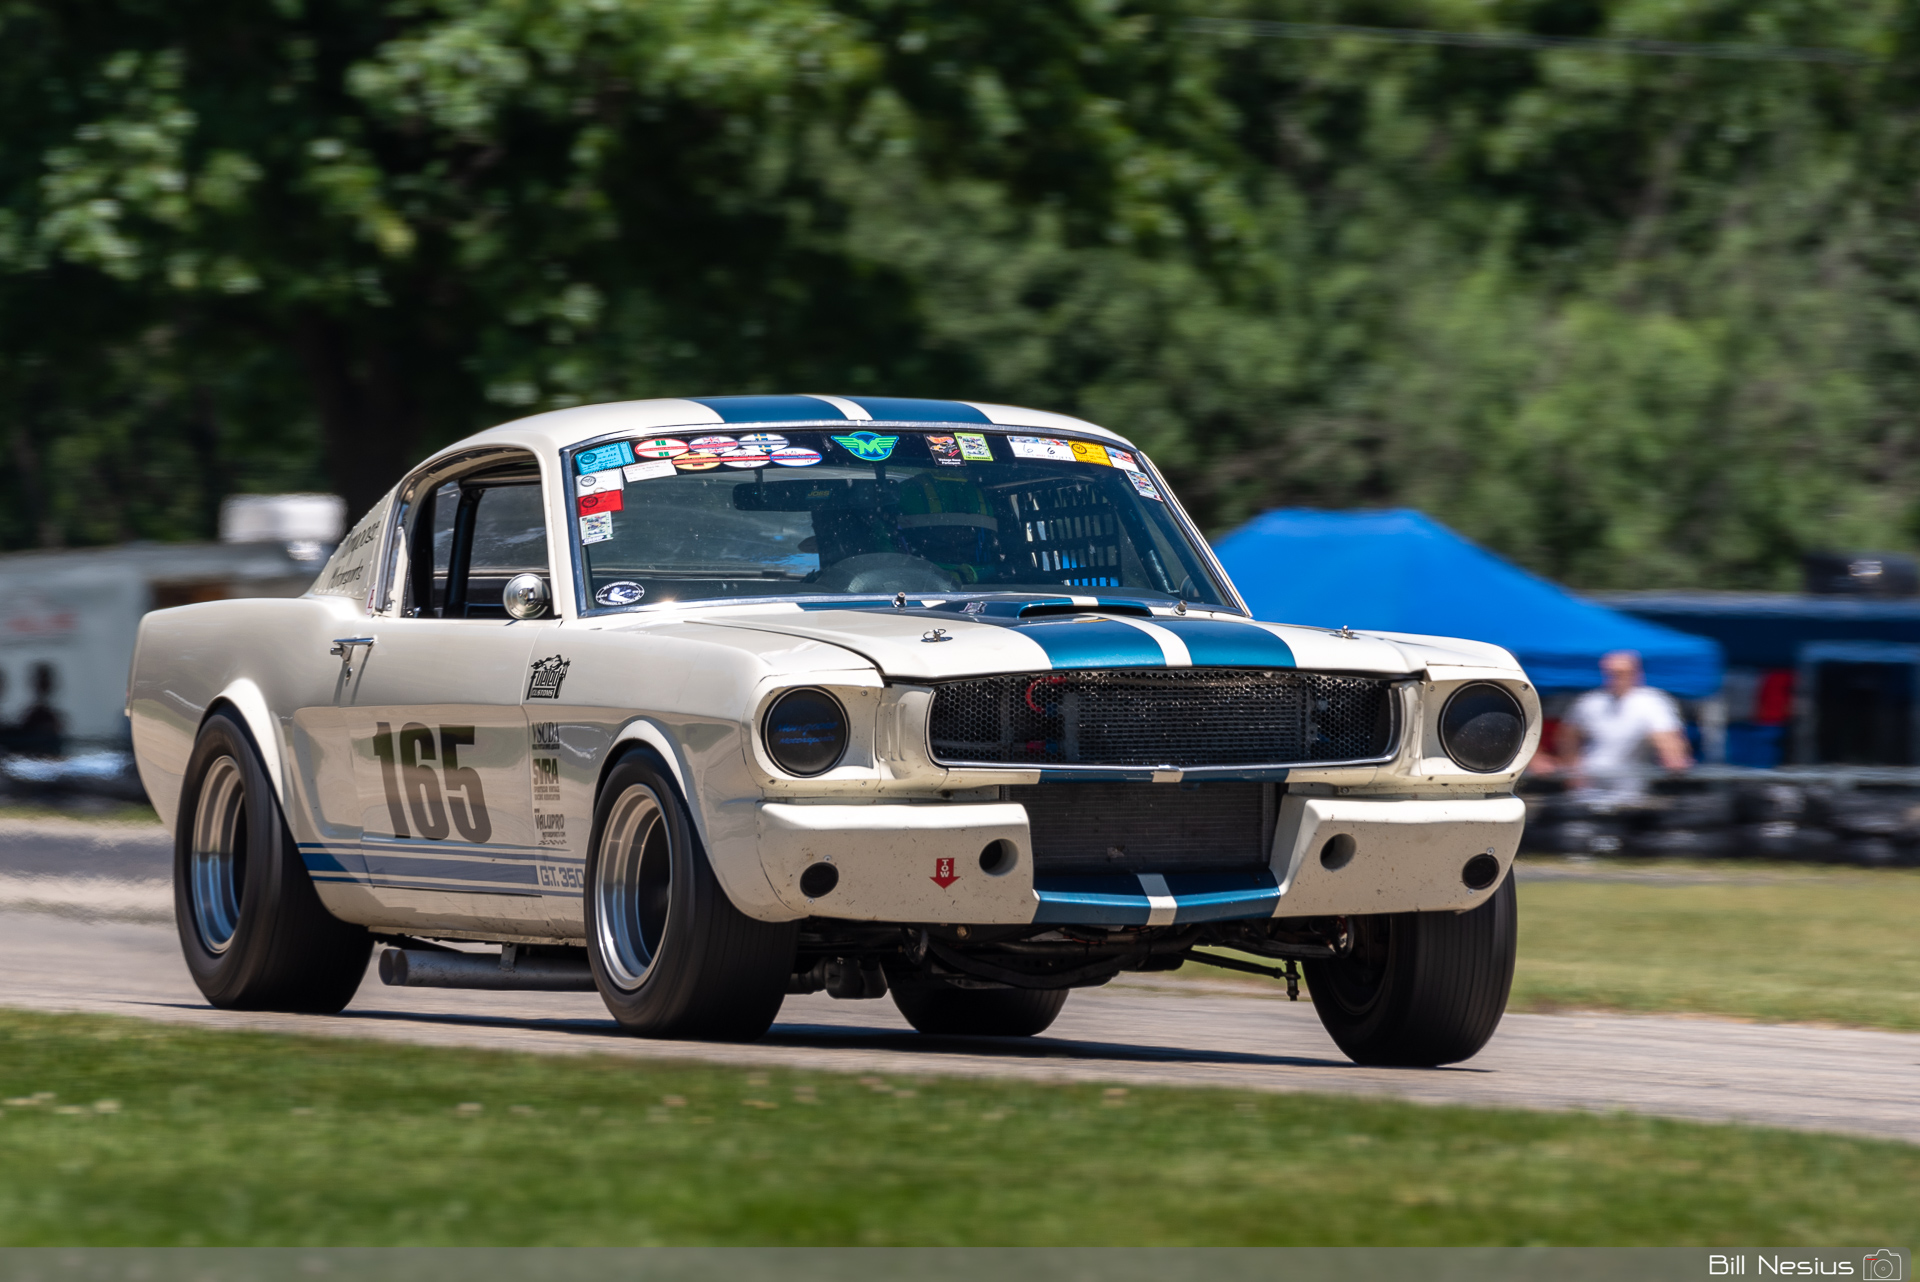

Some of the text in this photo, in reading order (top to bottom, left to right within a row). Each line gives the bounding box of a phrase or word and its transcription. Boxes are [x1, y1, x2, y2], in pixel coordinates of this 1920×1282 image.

[531, 722, 560, 743] VSCDA
[372, 722, 492, 844] 165
[939, 859, 950, 878] TOW
